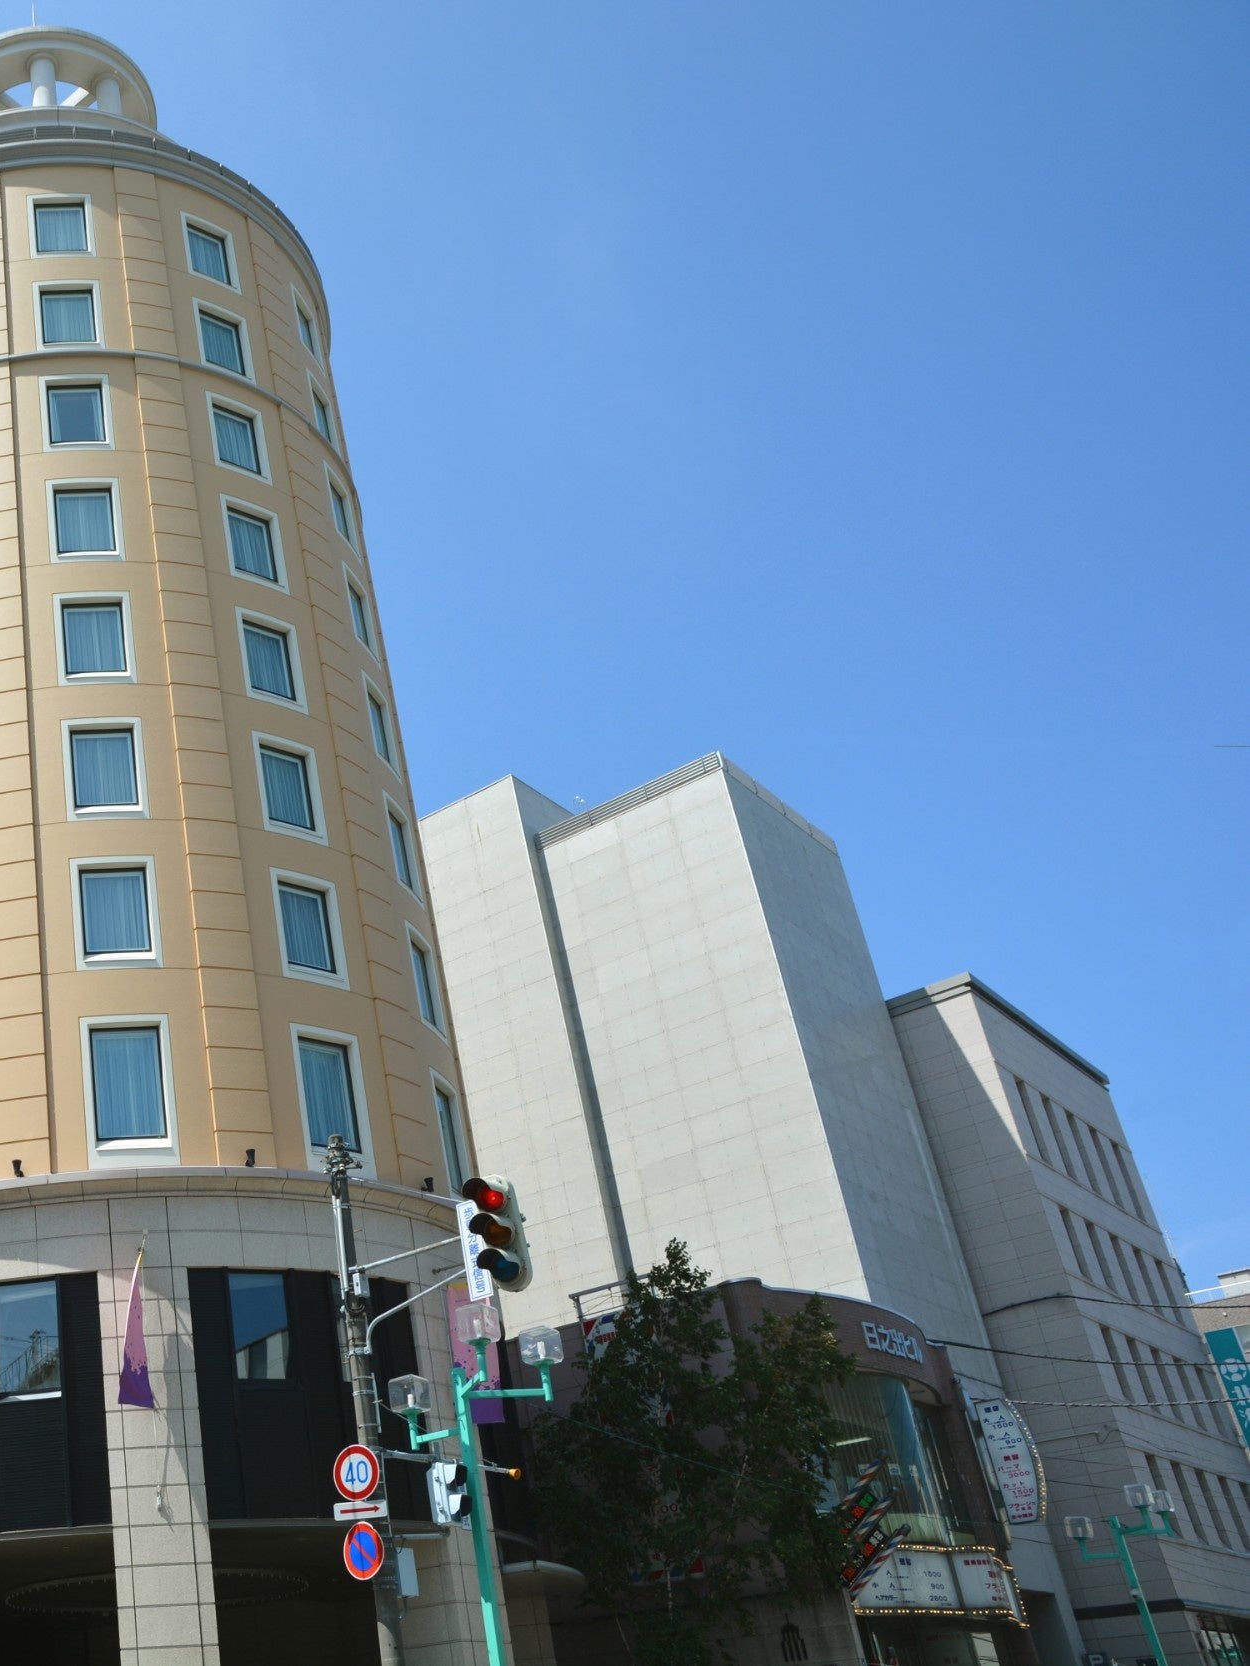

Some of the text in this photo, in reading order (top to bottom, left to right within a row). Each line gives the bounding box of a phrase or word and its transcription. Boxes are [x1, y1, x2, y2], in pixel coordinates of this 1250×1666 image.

[860, 1321, 924, 1364] 日之出ビル
[993, 1422, 1013, 1430] 1500
[345, 1460, 369, 1485] 40
[998, 1464, 1019, 1472] パーマ
[1008, 1470, 1029, 1479] 3000
[1003, 1480, 1024, 1489] カット
[1013, 1488, 1034, 1496] 1500
[1088, 1654, 1104, 1666] P
